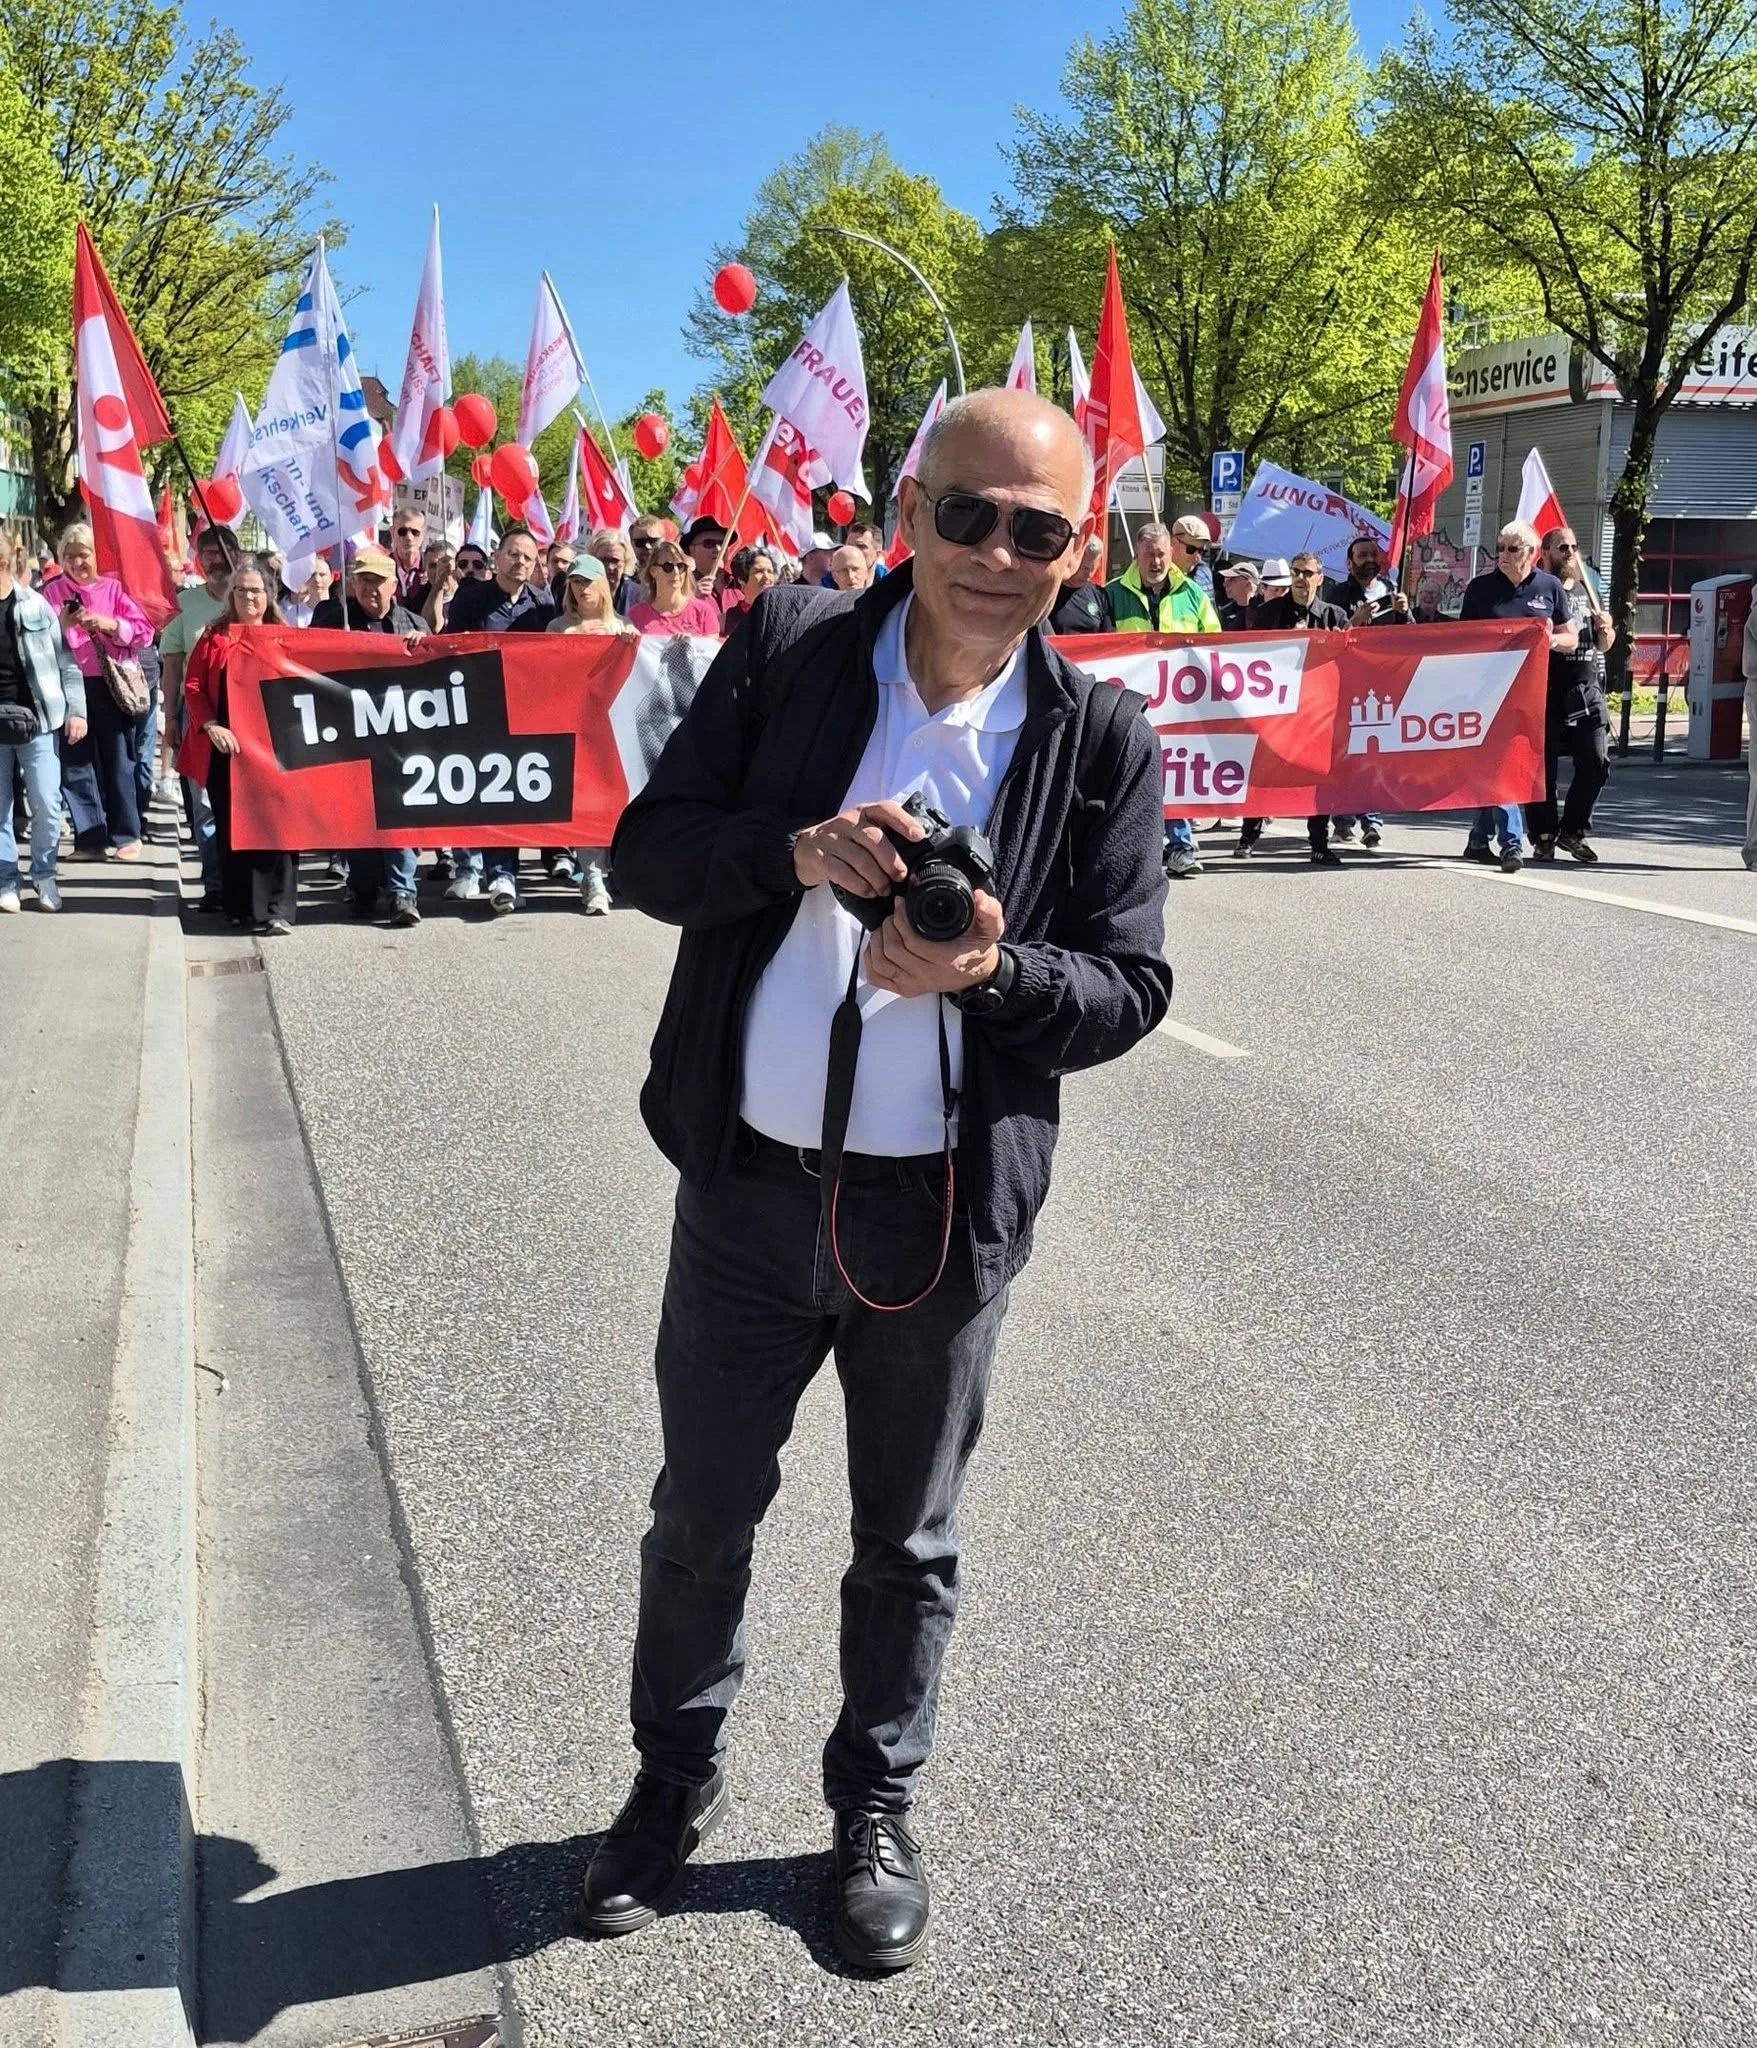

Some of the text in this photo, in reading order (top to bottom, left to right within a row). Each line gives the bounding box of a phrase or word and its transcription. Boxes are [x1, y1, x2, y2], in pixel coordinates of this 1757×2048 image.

[1218, 457, 1237, 489] P
[304, 491, 335, 531] und
[1147, 651, 1288, 710] Jobs,
[293, 670, 469, 745] 1. Mai
[1400, 711, 1482, 744] DGB
[402, 752, 552, 806] 2026
